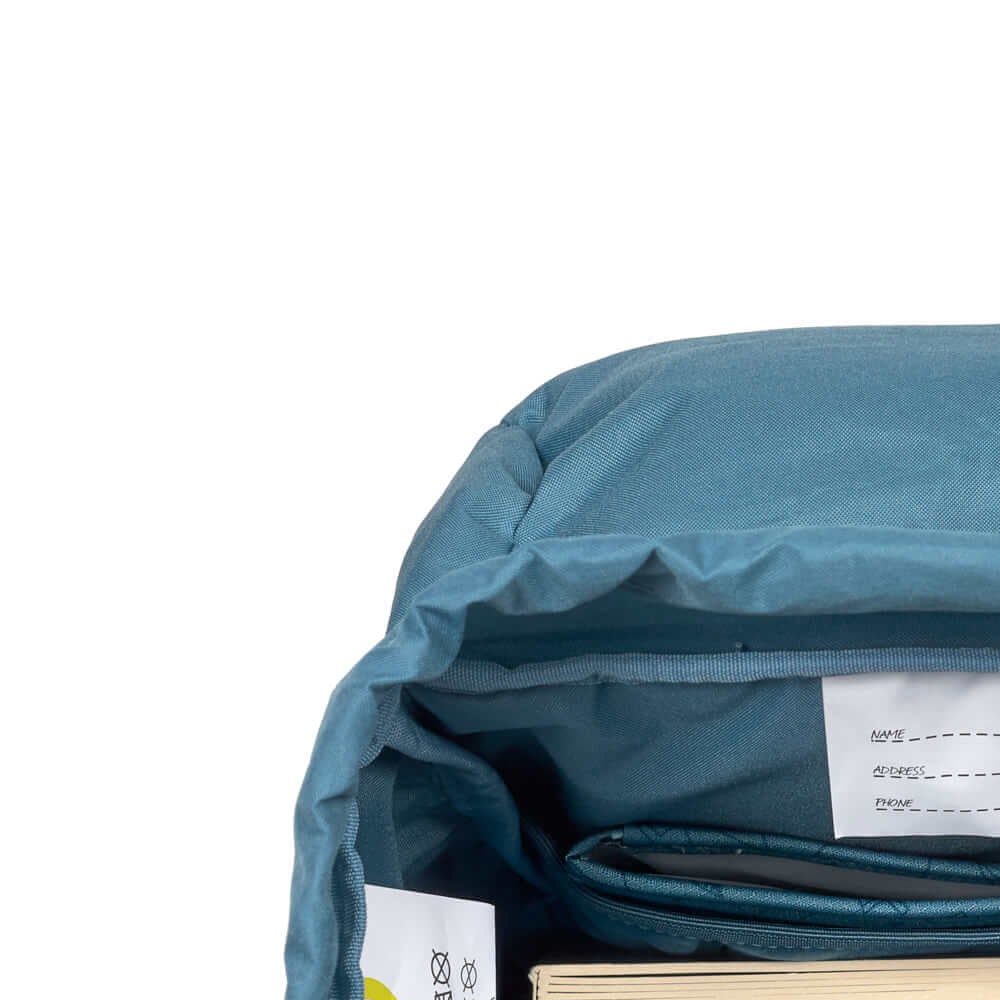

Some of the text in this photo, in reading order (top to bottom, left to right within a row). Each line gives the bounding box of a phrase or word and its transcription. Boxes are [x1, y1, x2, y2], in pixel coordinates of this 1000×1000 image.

[871, 728, 905, 740] NAME
[873, 764, 926, 776] ADDRESS
[875, 797, 913, 807] PHONE
